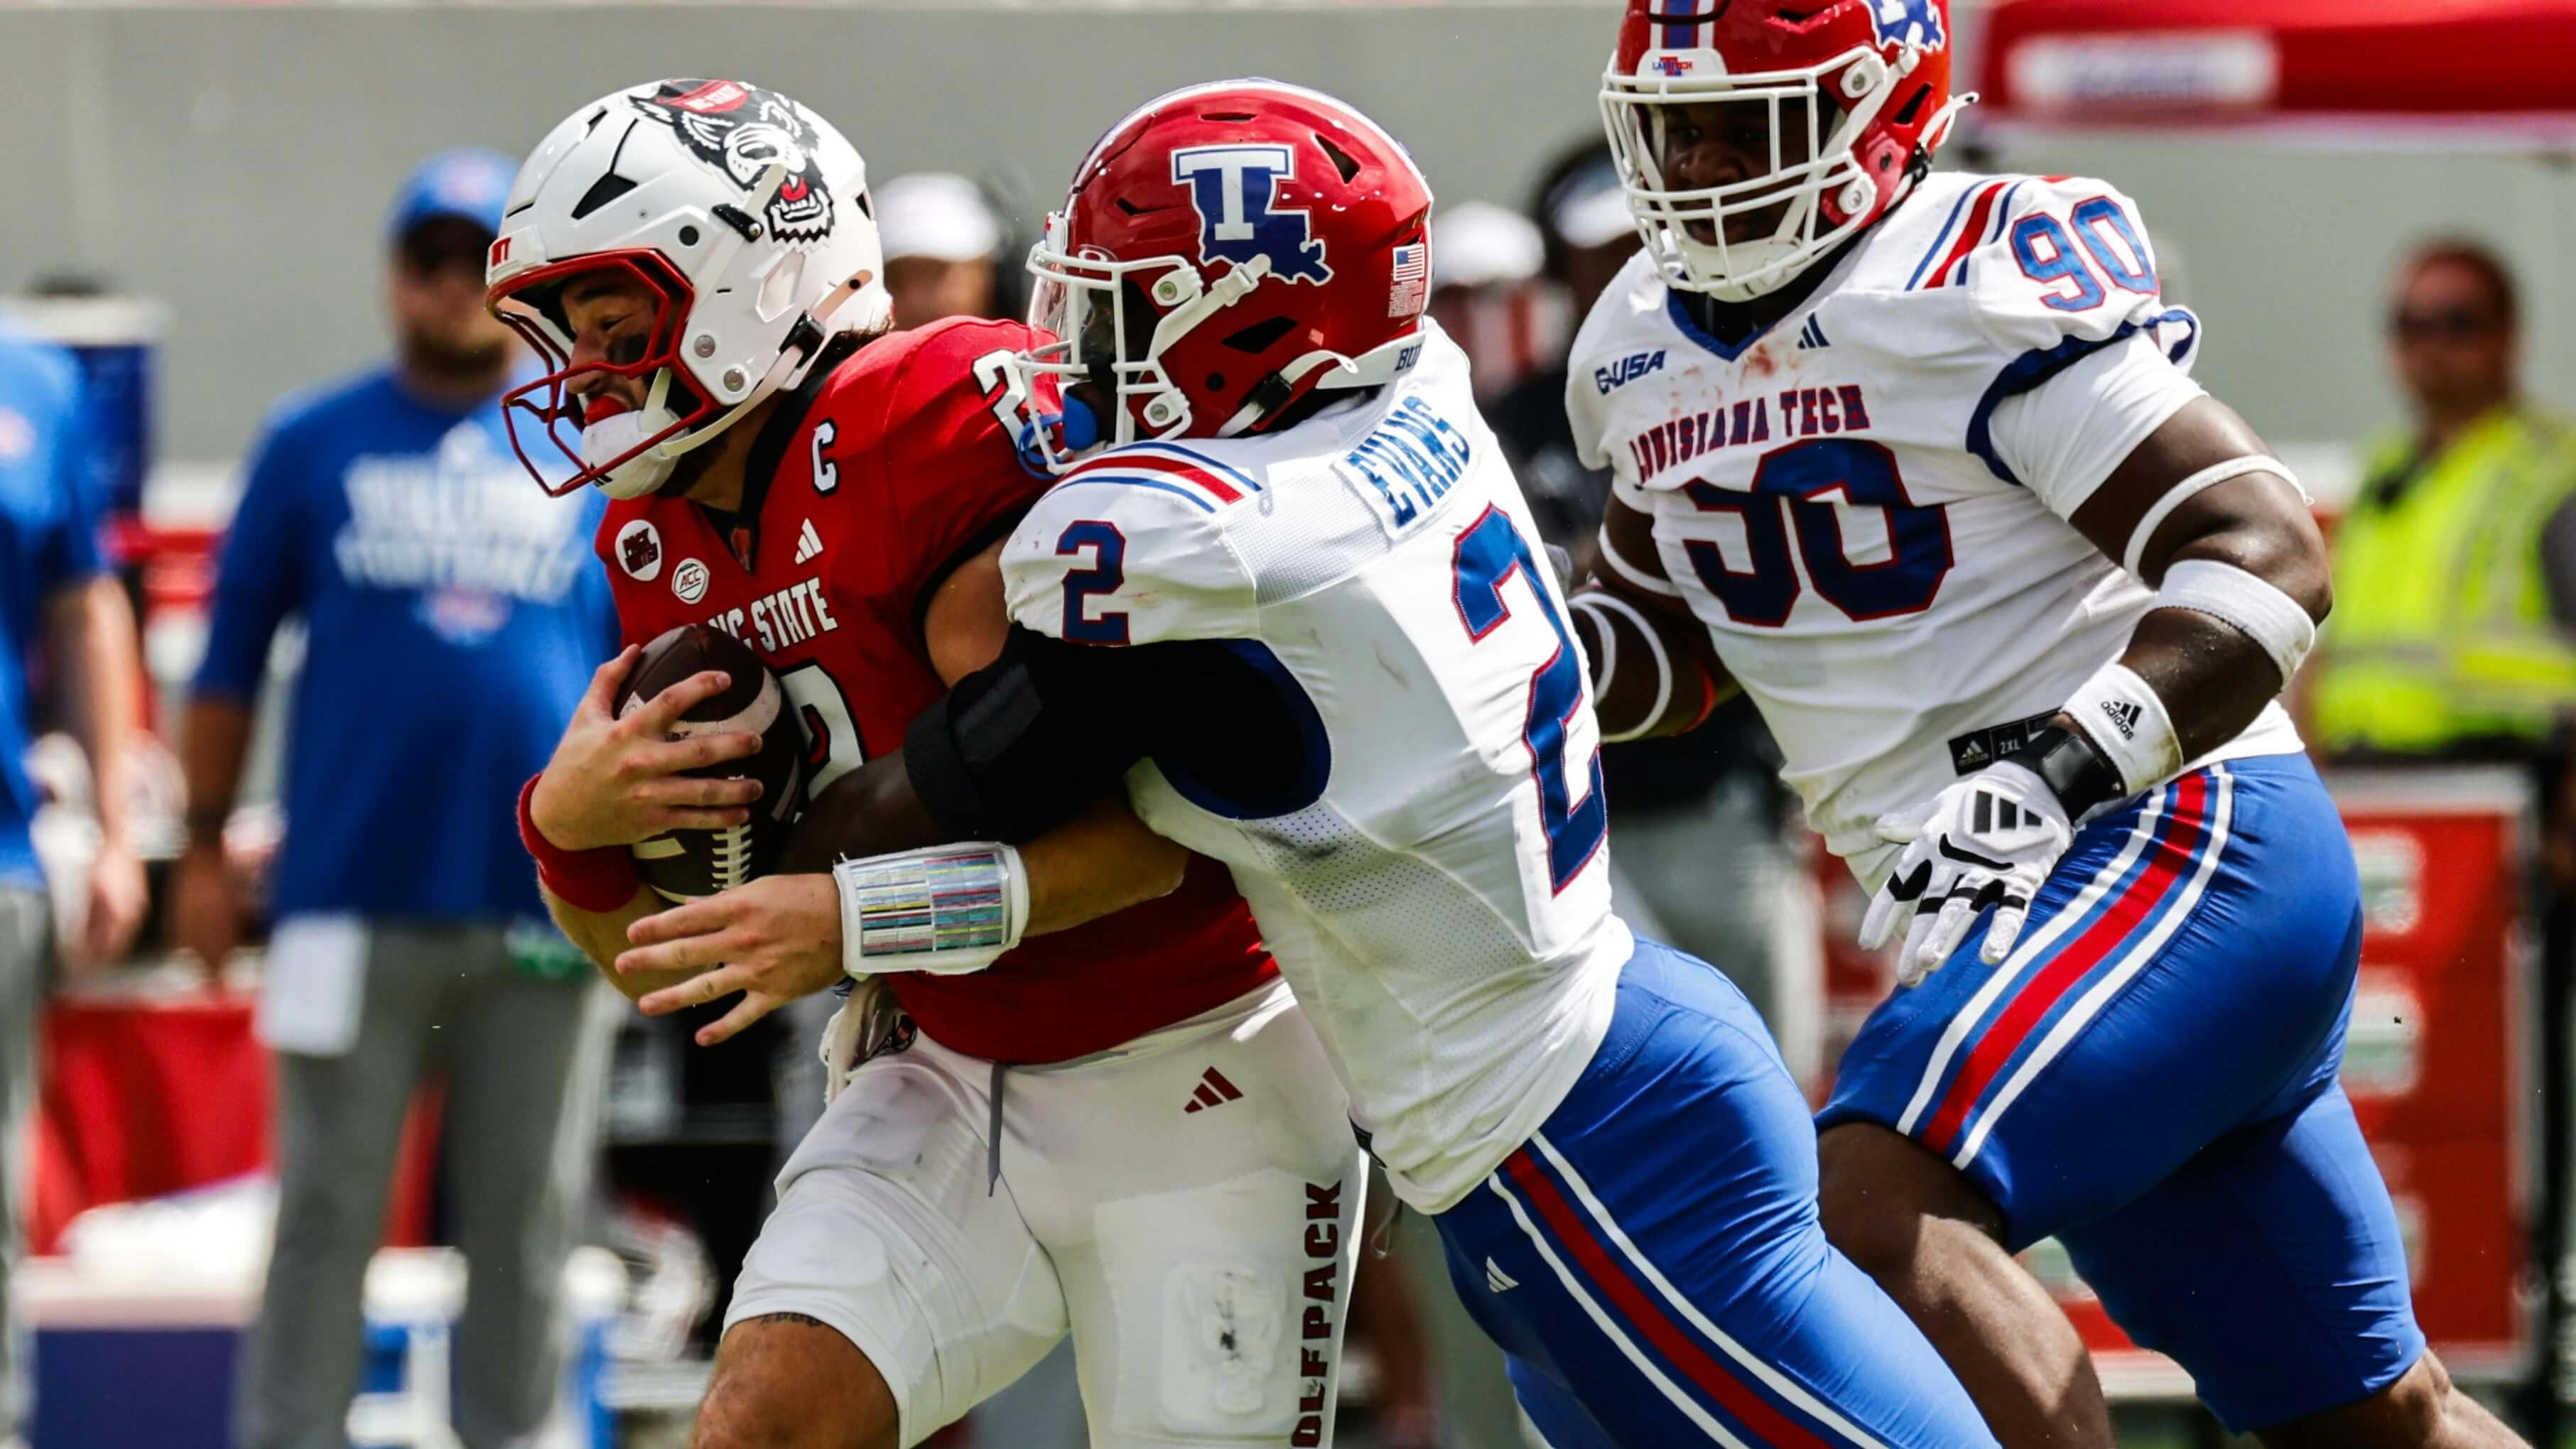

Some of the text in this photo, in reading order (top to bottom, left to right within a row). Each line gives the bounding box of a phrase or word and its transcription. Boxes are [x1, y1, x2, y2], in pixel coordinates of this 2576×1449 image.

[2011, 195, 2160, 311] 90
[811, 420, 838, 494] C
[1347, 396, 1470, 529] EVANS
[1629, 384, 1871, 485] LOUISIANA TECH
[680, 568, 701, 591] ACC
[750, 576, 838, 653] STATE
[1056, 519, 1130, 646] 2
[1451, 500, 1608, 899] 2
[2101, 700, 2134, 741] adidas
[1999, 738, 2022, 755] 2XL
